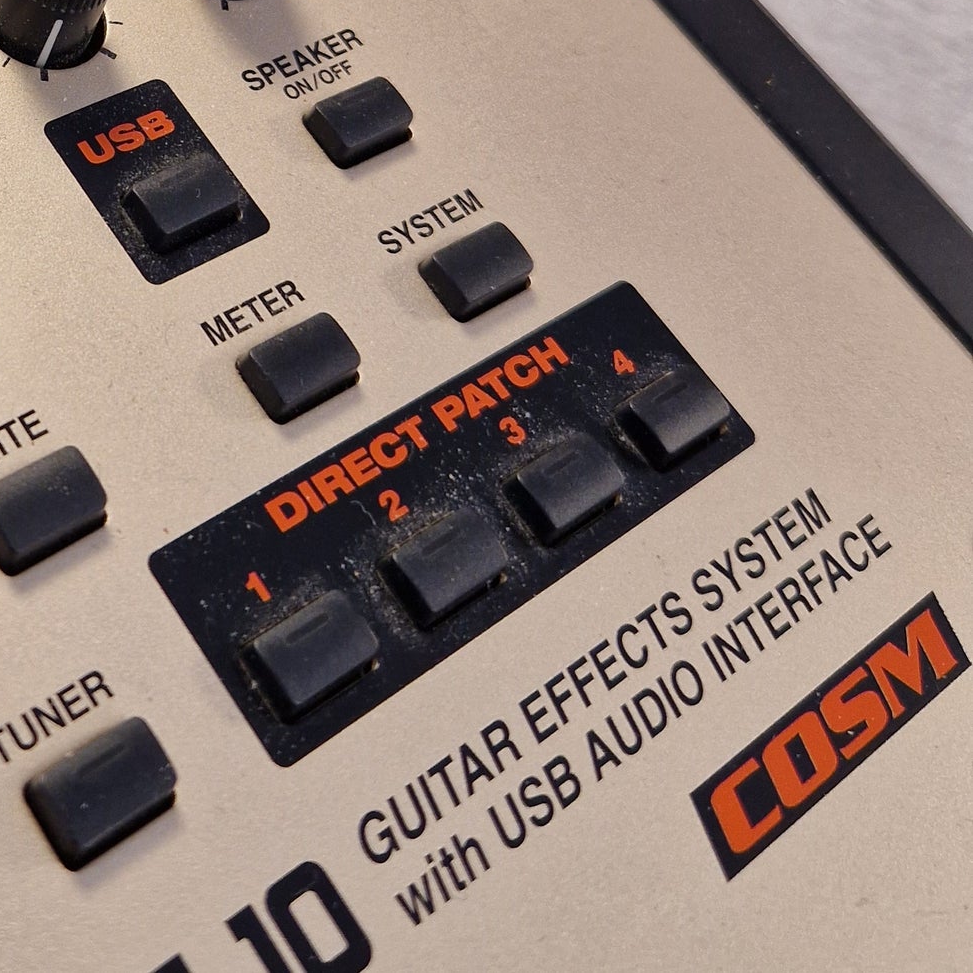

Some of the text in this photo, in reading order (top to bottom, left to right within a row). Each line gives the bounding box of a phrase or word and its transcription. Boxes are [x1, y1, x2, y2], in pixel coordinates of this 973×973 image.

[241, 28, 364, 92] SPEAKER
[283, 60, 354, 100] ON/OFF
[77, 109, 175, 164] USB
[377, 188, 484, 256] SYSTEM
[200, 279, 306, 347] METER
[612, 349, 636, 378] 4
[263, 336, 571, 533] DIRECT PATCH
[499, 416, 527, 446] 3
[379, 490, 409, 523] 2
[244, 571, 271, 603] 1
[358, 488, 833, 866] GUITAR EFFECTS SYSTEM
[395, 513, 893, 927] with USB AUDIO INTERFACE
[710, 606, 959, 855] COSM
[148, 860, 372, 973] 10
